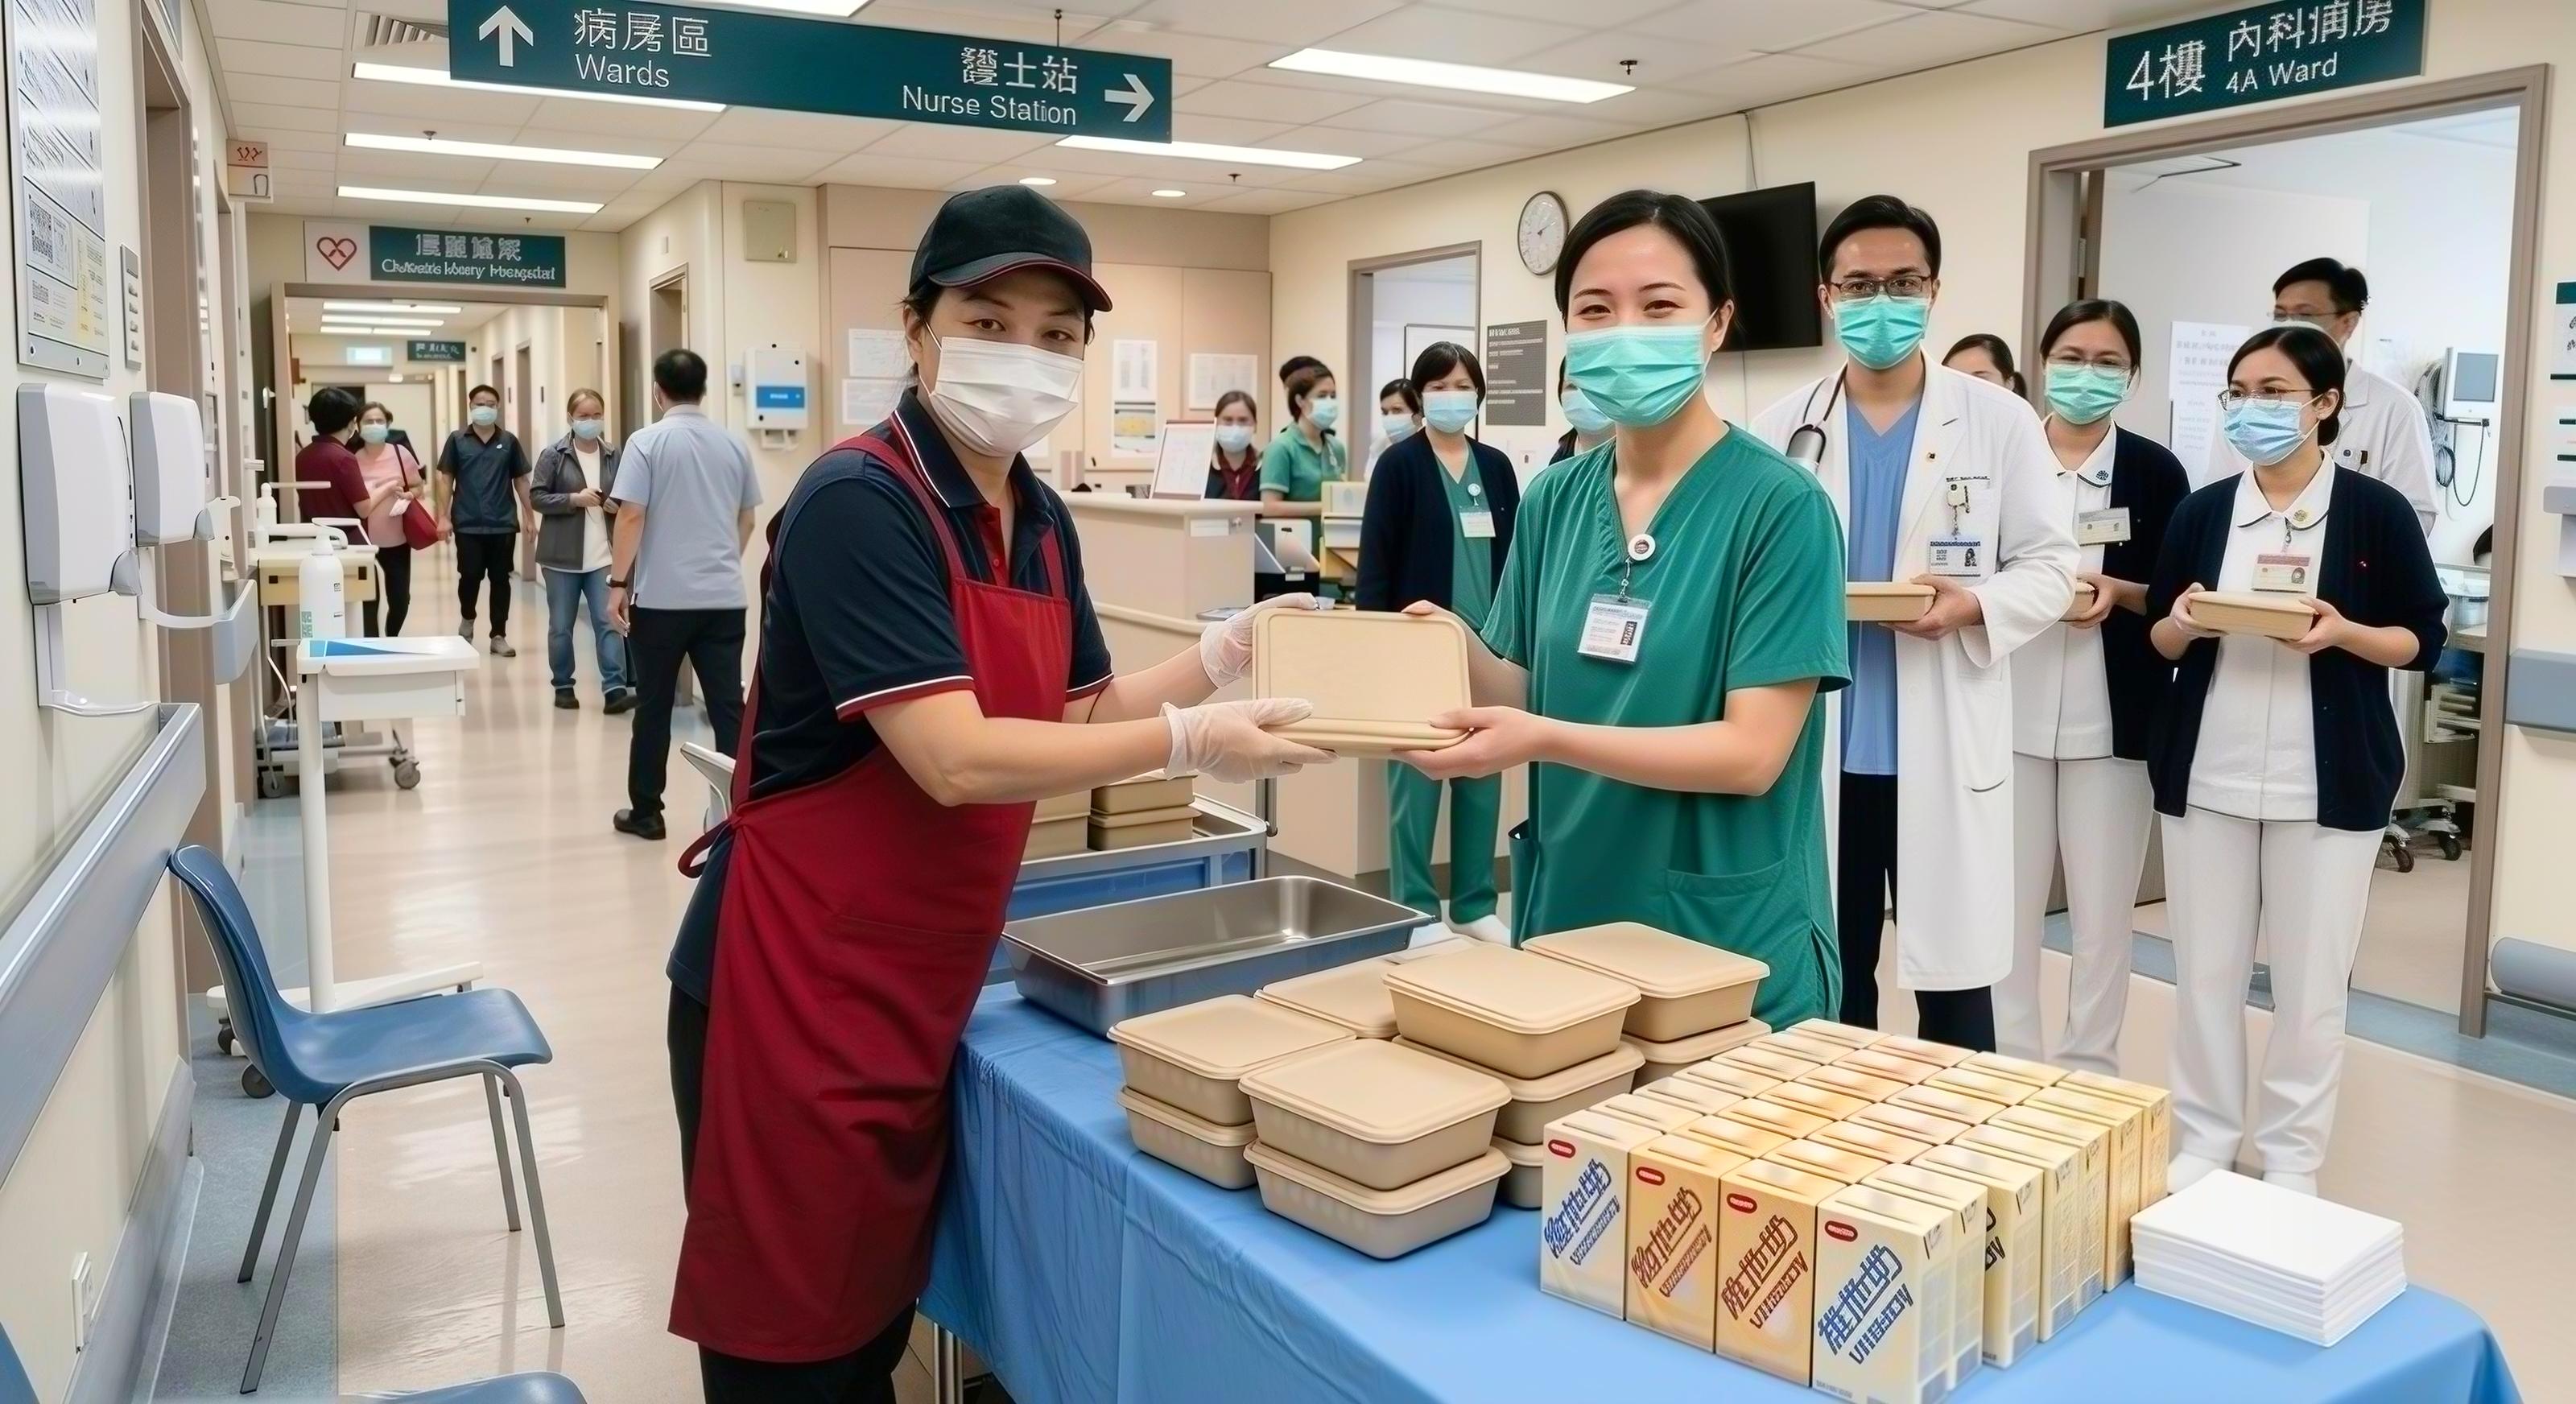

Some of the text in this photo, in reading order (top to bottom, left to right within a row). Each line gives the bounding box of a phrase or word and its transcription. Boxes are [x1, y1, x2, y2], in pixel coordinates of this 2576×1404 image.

[574, 52, 670, 89] Wards
[2225, 51, 2338, 94] 4A Ward
[902, 85, 1077, 126] Nurse Station
